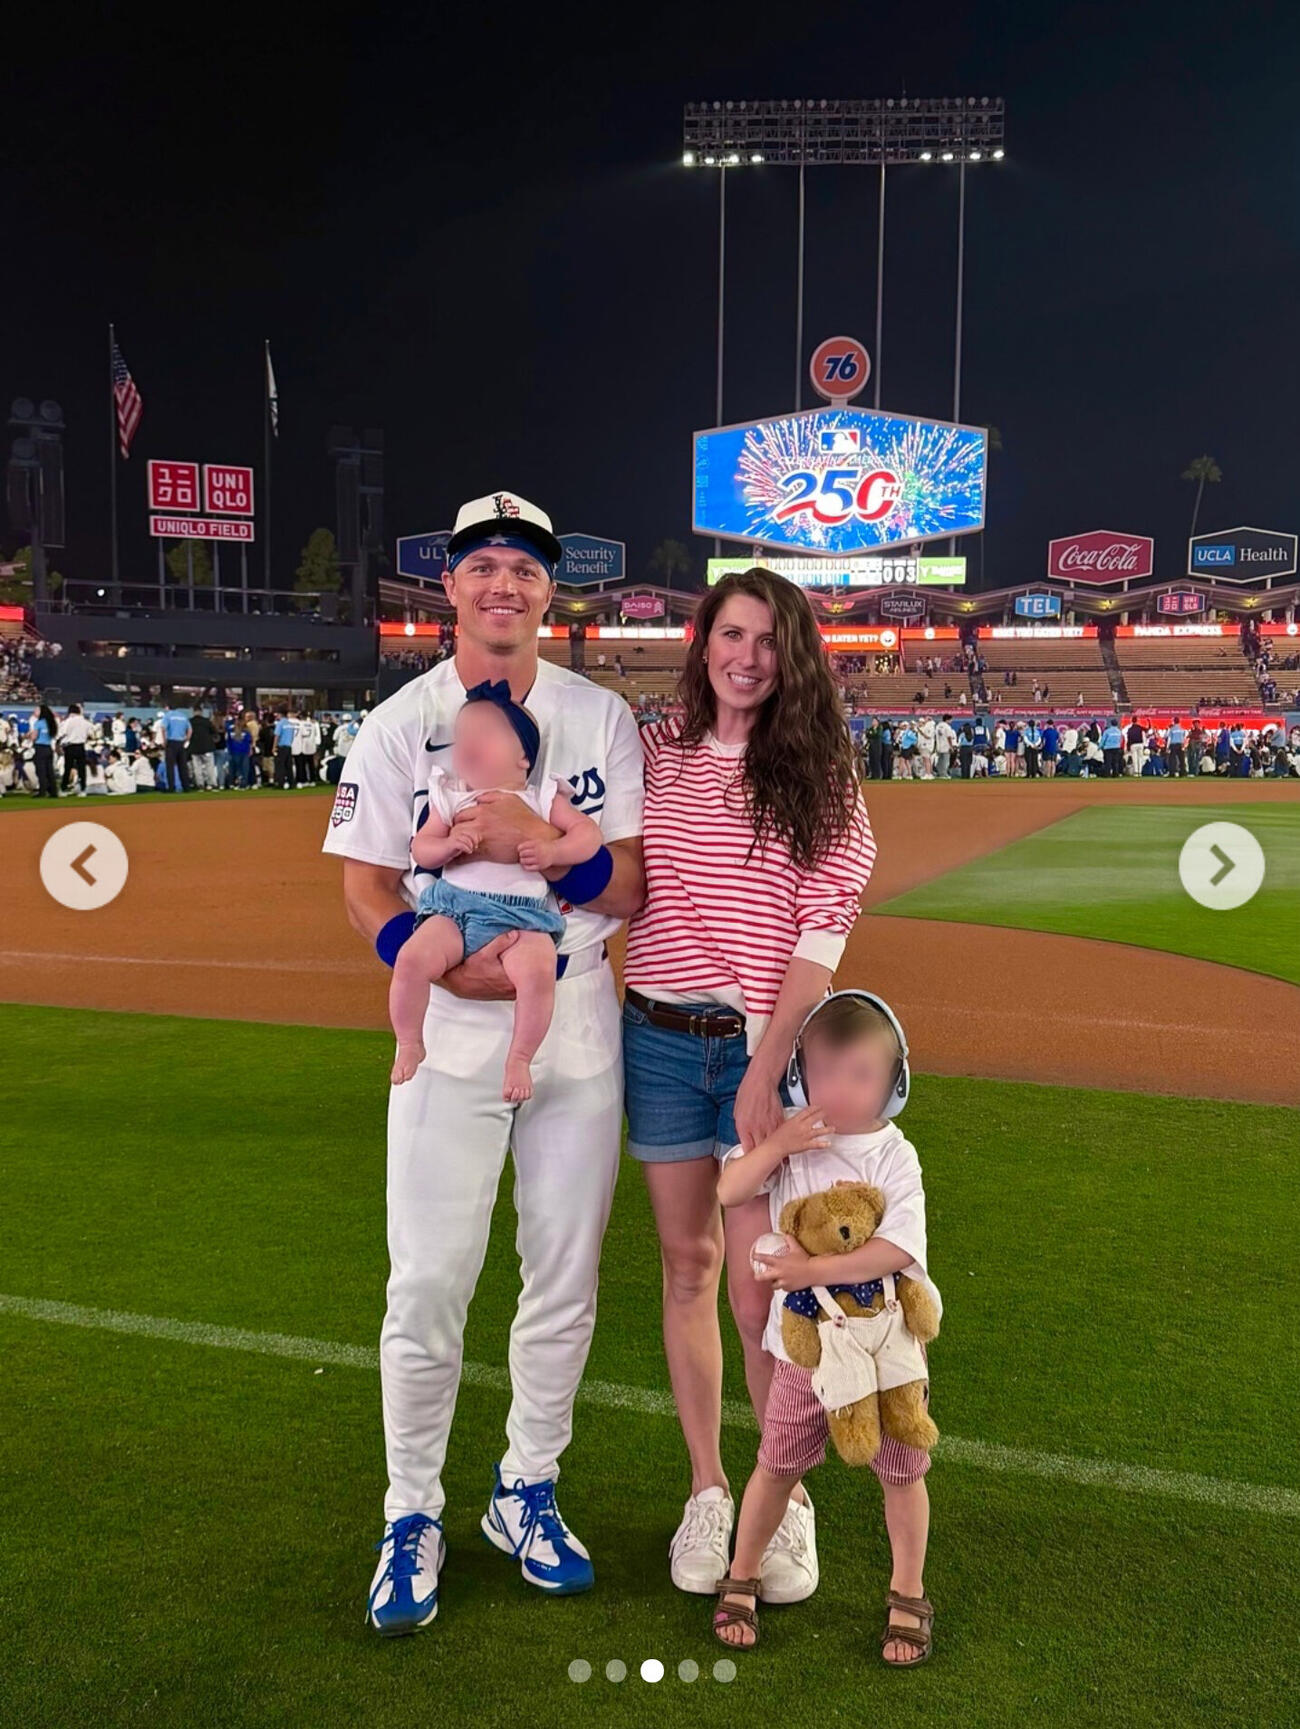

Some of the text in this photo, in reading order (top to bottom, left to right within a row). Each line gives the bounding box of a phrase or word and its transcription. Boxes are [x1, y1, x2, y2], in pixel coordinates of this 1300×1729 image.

[823, 351, 859, 382] 76
[157, 468, 192, 485] ユニ
[212, 471, 244, 489] UNI
[157, 486, 192, 503] クロ
[212, 491, 247, 508] QLO
[157, 520, 248, 537] UNIQLO FIELD
[565, 546, 616, 562] Security
[1058, 543, 1143, 571] Coca-Cola
[1197, 547, 1288, 561] UCLA Health
[566, 561, 609, 574] Benefit
[884, 601, 922, 609] STARLUX
[1020, 598, 1056, 613] TEL
